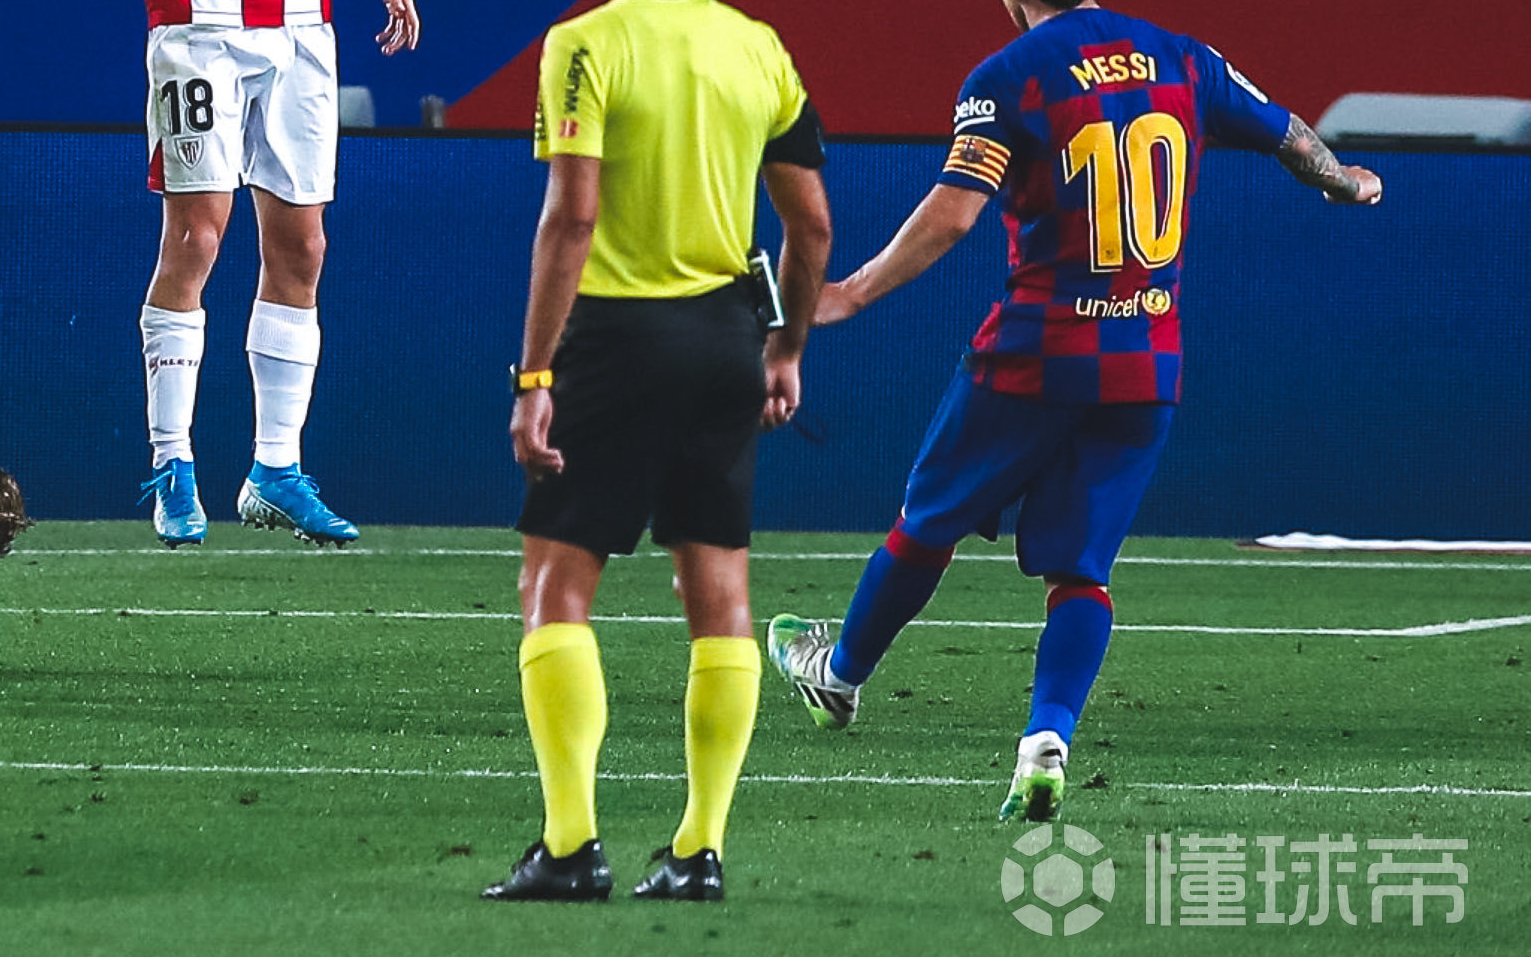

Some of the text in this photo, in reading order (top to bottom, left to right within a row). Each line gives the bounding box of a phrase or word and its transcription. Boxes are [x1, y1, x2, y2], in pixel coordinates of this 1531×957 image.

[1071, 52, 1157, 90] MESSI
[160, 78, 214, 136] 18
[1062, 111, 1187, 273] 10
[1075, 290, 1142, 318] unicef
